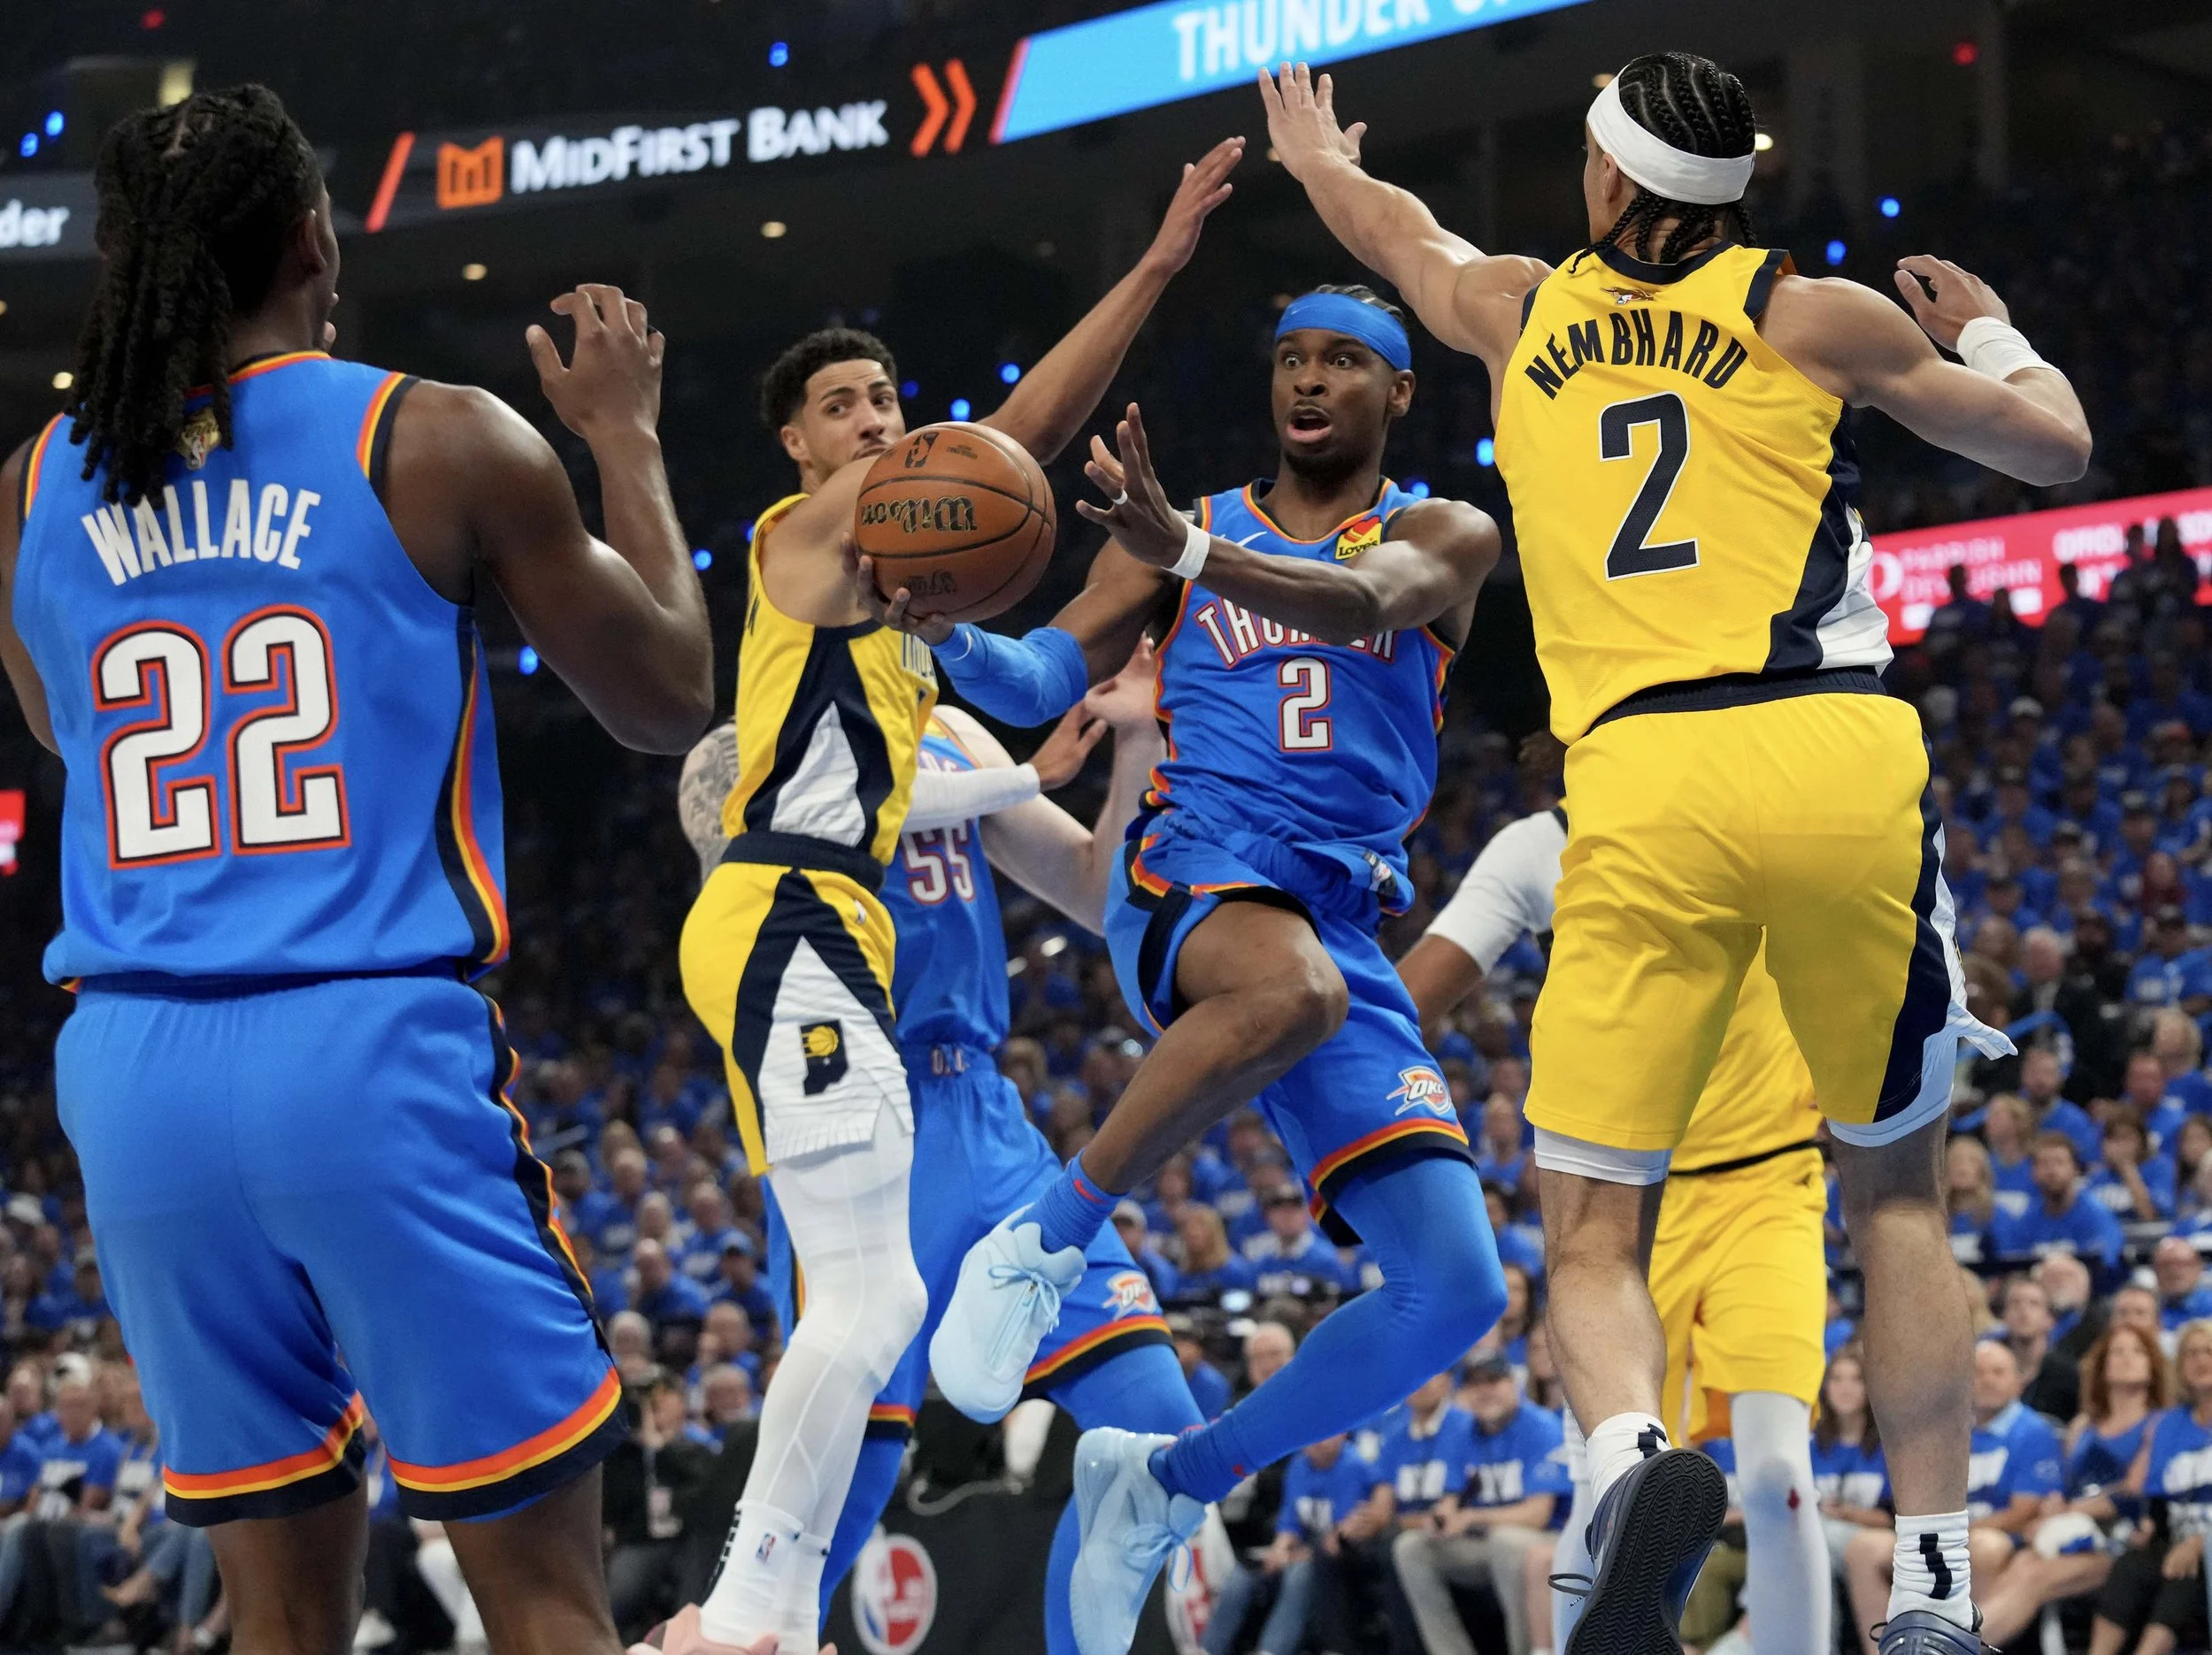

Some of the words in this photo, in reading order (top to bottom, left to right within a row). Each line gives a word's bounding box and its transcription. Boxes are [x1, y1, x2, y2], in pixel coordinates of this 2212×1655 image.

[1524, 308, 1748, 401] NEMBHARD
[81, 479, 322, 586] WALLACE
[861, 495, 979, 534] Wilson
[1598, 390, 1701, 582] 2
[90, 603, 352, 870] 22
[1277, 653, 1333, 753] 2
[900, 819, 977, 907] 55
